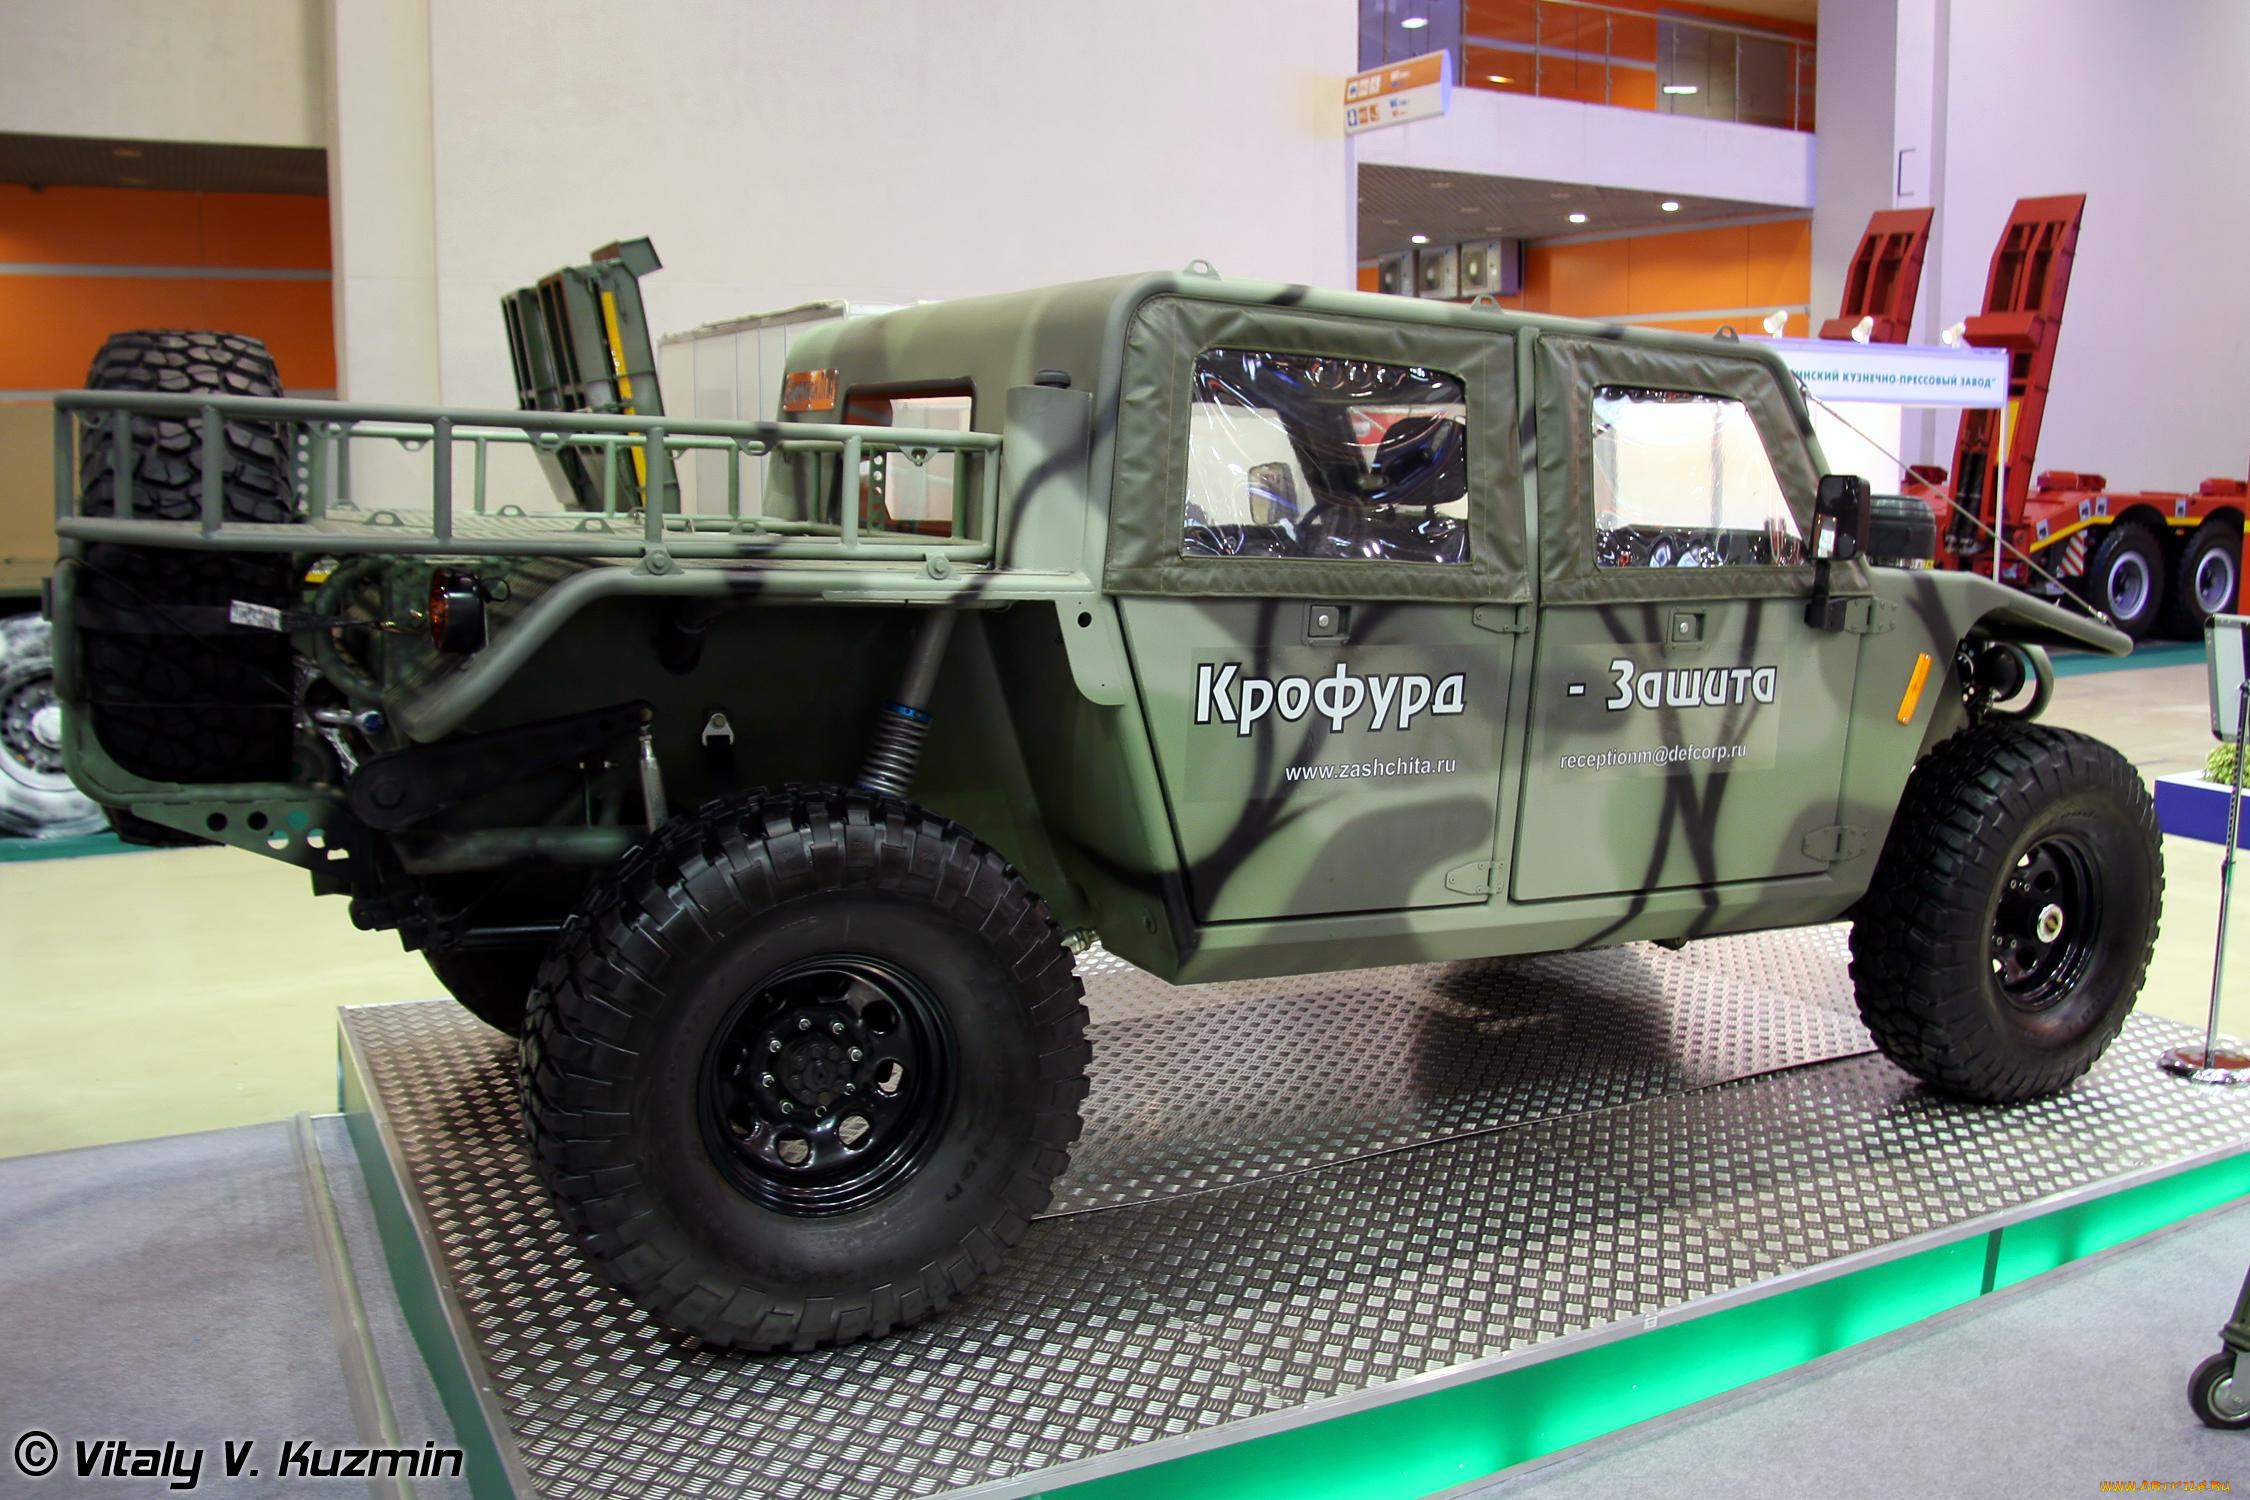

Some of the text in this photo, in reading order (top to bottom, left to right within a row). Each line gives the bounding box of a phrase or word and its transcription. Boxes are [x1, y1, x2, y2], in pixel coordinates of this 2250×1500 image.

[1842, 371, 1957, 386] КУЗНЕЧНО-ПРЕССОВЫЙ
[1285, 756, 1456, 781] www.zashchita.ru
[1560, 742, 1747, 771] receptionm@defcorp.ru
